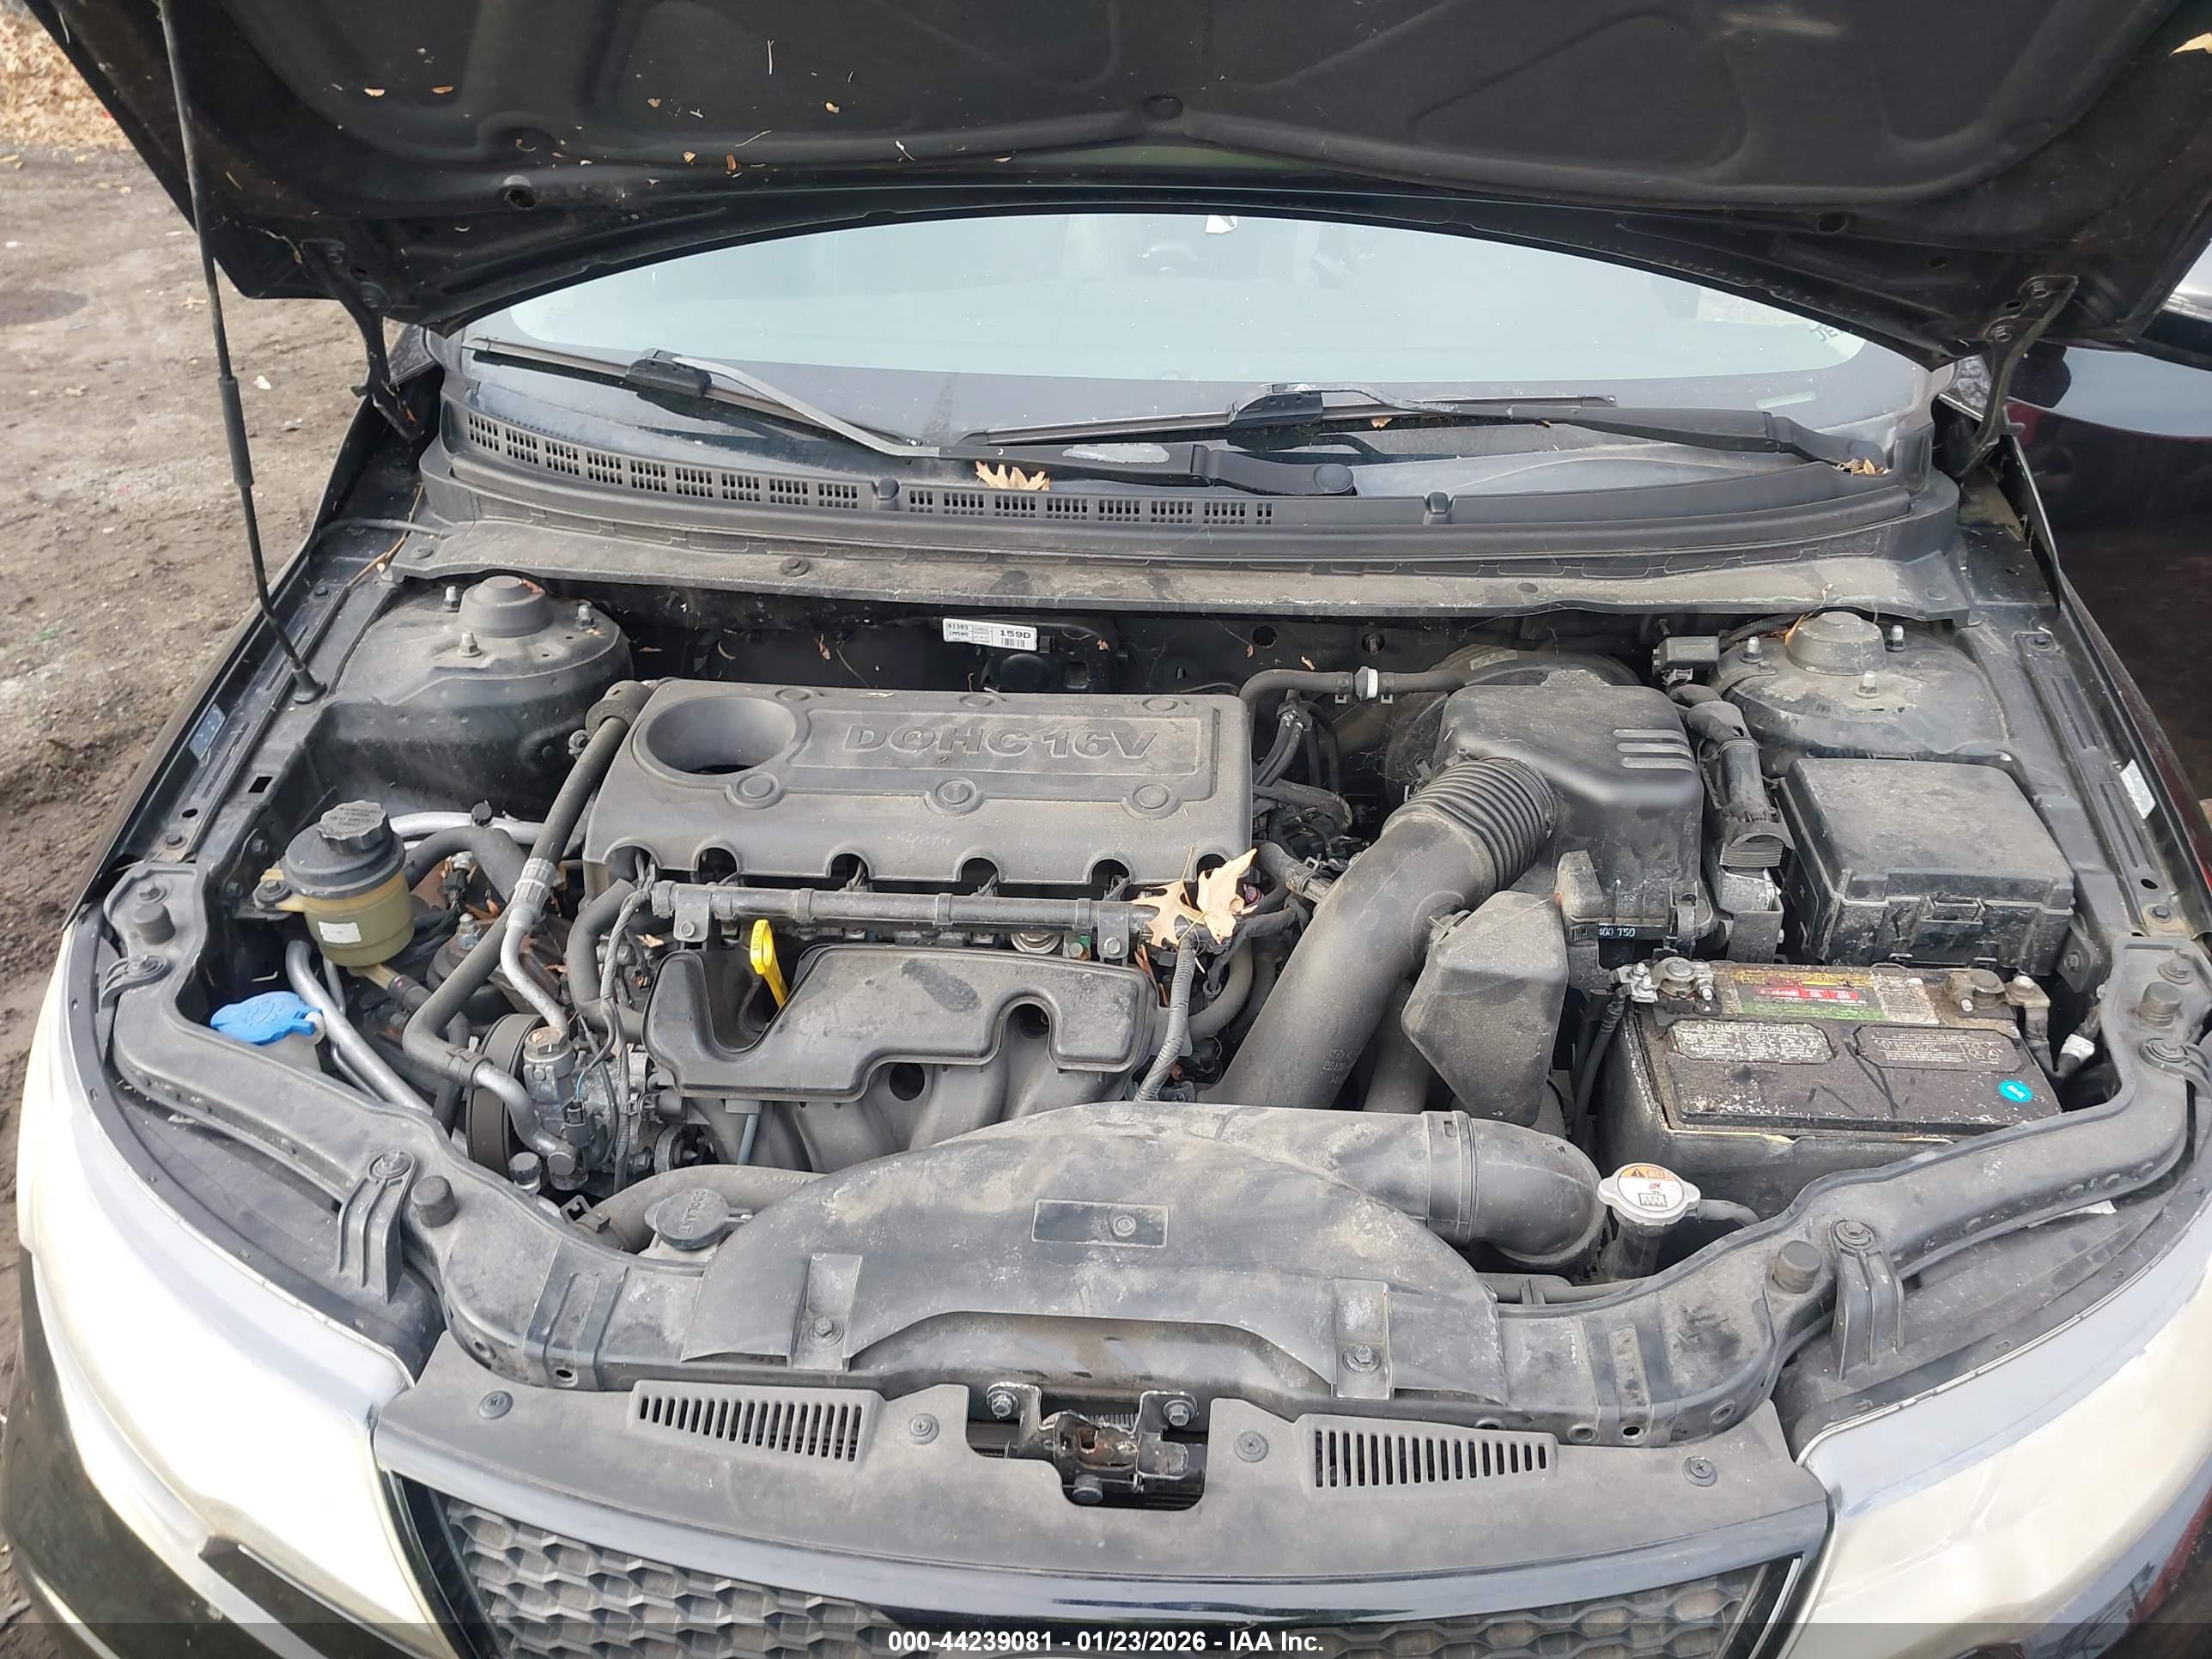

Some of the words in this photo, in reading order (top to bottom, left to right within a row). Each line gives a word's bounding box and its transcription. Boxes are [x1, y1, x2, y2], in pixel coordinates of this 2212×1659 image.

[1000, 629, 1030, 639] 159D
[844, 725, 1033, 757] DOHC
[1041, 729, 1158, 759] 16V
[679, 1188, 707, 1234] COOLANT
